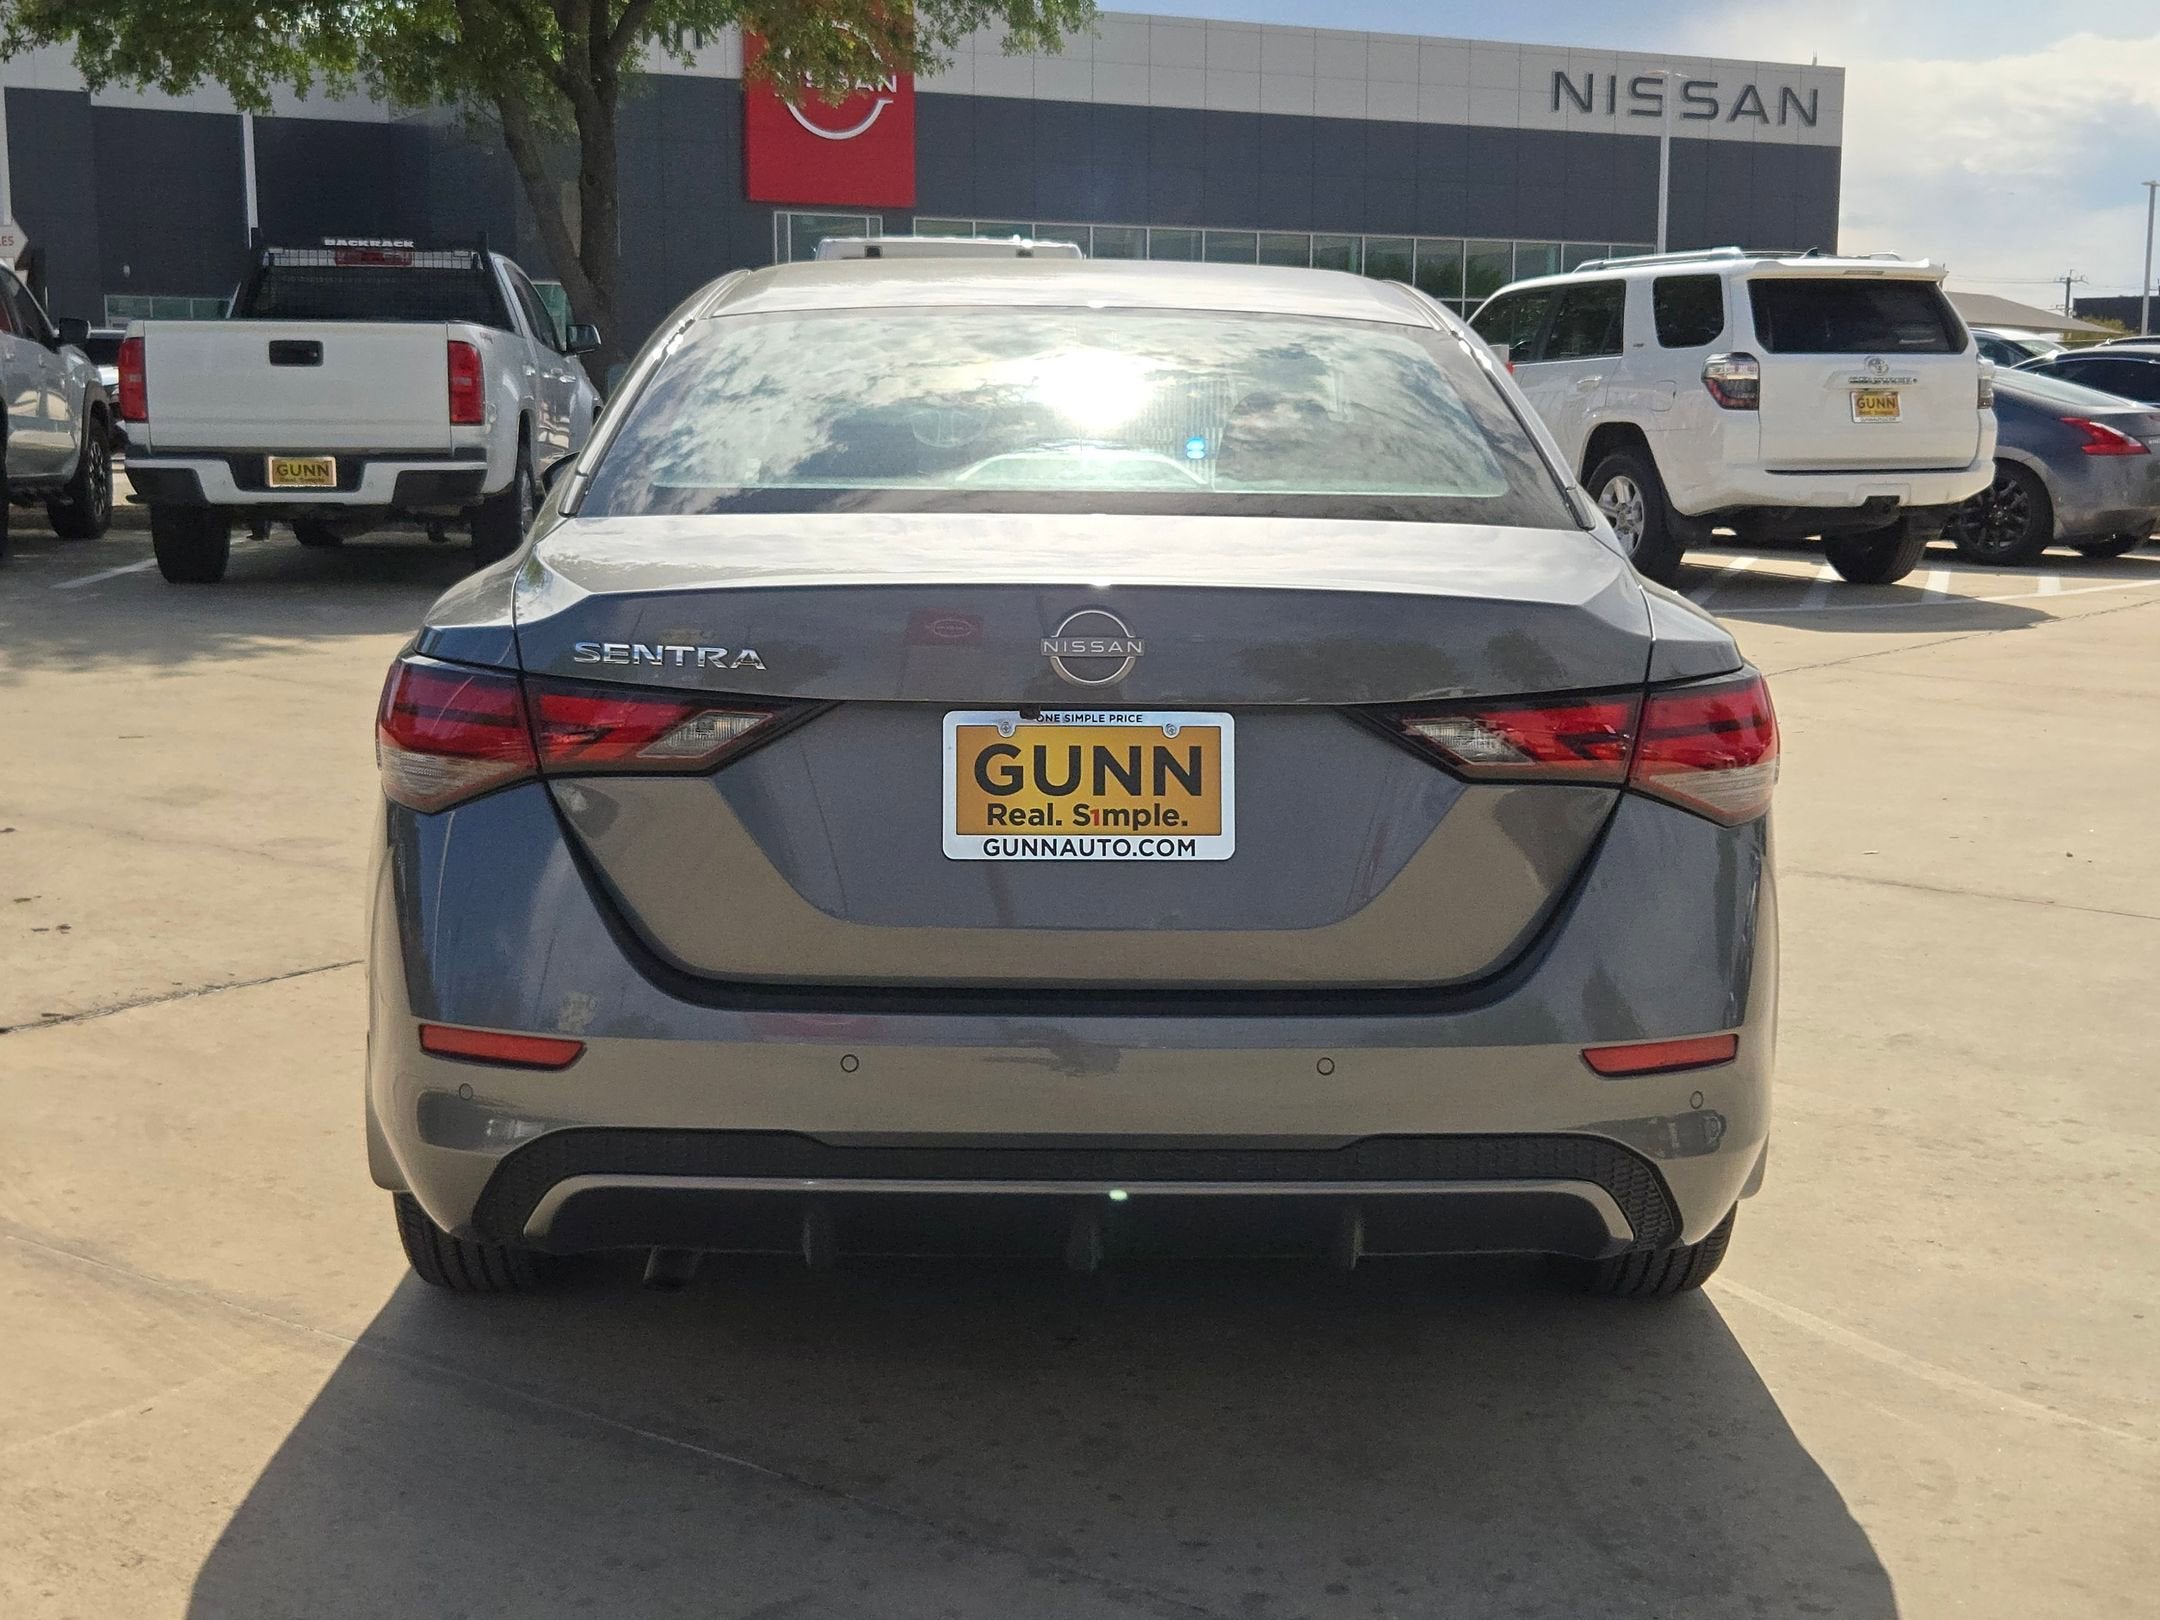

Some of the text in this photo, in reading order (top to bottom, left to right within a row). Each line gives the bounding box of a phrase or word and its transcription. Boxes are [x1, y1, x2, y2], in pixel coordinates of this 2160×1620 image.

[1551, 71, 1819, 127] NISSAN
[0, 235, 15, 246] ES
[324, 239, 414, 248] BACKRACK
[1857, 397, 1896, 409] GUNN
[277, 463, 330, 477] GUNN
[1043, 641, 1142, 653] NISSAN
[574, 641, 767, 670] SENTRA
[1036, 714, 1143, 723] ONE SIMPLE PRICE
[974, 743, 1202, 797] GUNN
[987, 803, 1062, 826] Real.
[982, 838, 1196, 857] GUNNAUTO.COM
